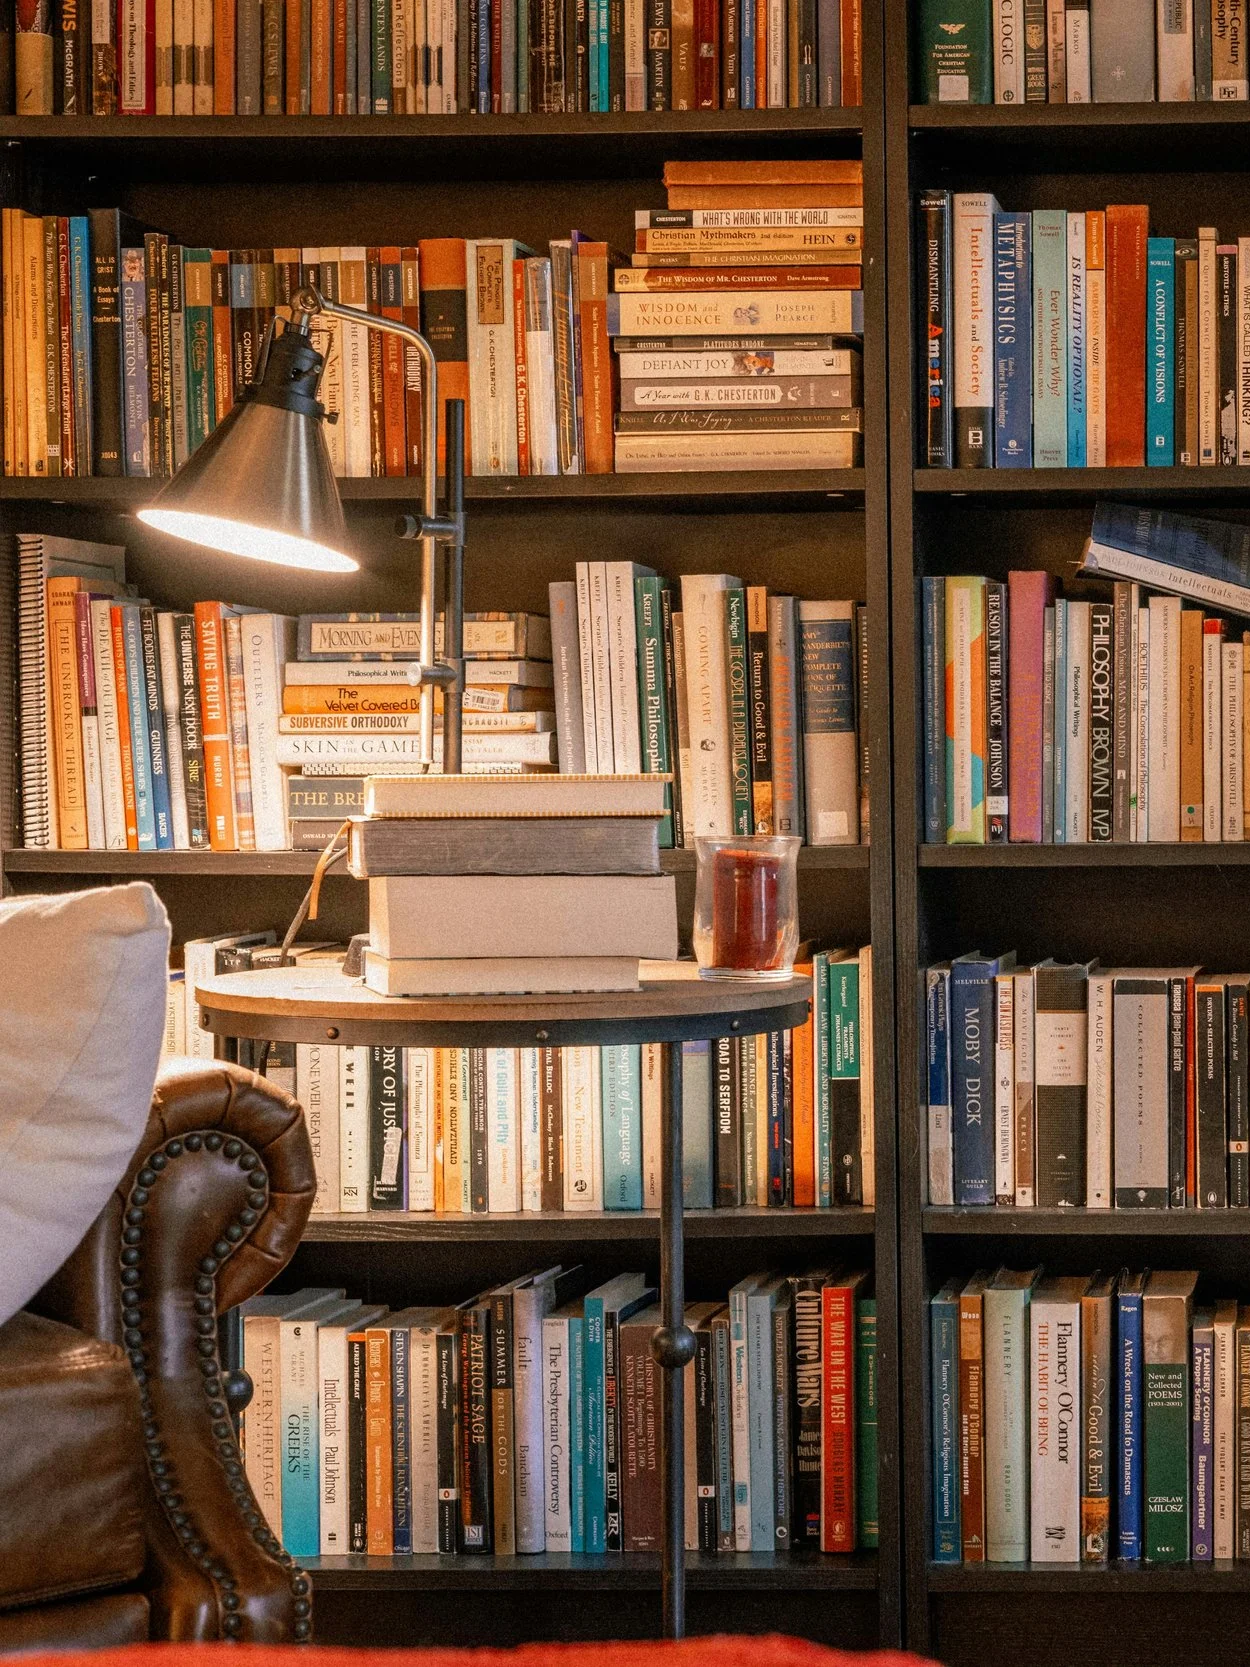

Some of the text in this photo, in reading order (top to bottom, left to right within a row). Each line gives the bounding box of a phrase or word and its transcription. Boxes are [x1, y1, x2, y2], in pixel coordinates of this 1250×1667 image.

[65, 39, 74, 87] McGRATH
[395, 15, 403, 84] Reflections
[1001, 16, 1014, 65] LOGIC
[654, 50, 663, 87] MARTIN
[652, 230, 756, 241] Christian Mythmakers
[702, 210, 829, 226] WHAT'S WRONG WITH THE WORLD
[802, 234, 836, 245] HEIN
[929, 239, 939, 312] DISMANTLING
[970, 227, 984, 321] Intellectuals
[997, 222, 1015, 345] METAPHYSICS
[642, 358, 729, 371] DEFIANT JOY
[1155, 279, 1166, 403] A CONFLICT OF VISIONS
[970, 345, 984, 397] Society
[200, 620, 220, 720] SAVING TRUTH
[645, 637, 657, 692] Summa
[988, 594, 1002, 726] REASON IN THE BALANCE
[325, 700, 408, 712] Velvet Covered
[337, 688, 358, 699] The
[753, 651, 767, 763] Return to Good & Evil
[289, 716, 409, 729] SUBVERSIVE ORTHODOXY
[292, 740, 340, 753] SKIN
[360, 739, 420, 753] GAME
[1092, 614, 1110, 837] PHILOSOPHY BROWN IVP
[213, 755, 222, 788] MURRAY
[989, 739, 1003, 788] JOHNSON
[1172, 1012, 1183, 1047] jean-paul
[719, 1037, 730, 1134] ROAD TO SERFDOM
[964, 1008, 982, 1125] MOBY DICK
[1174, 1048, 1183, 1072] sartre
[620, 1106, 631, 1165] Language
[830, 1296, 846, 1425] THE WAR ON THE WEST
[1148, 1381, 1182, 1389] Collected
[470, 1334, 486, 1444] PATRIOT SAGE
[1038, 1321, 1049, 1456] THE HABIT OF BEING
[1055, 1322, 1073, 1463] Flannery O'Connor
[288, 1414, 300, 1473] GREEKS
[324, 1378, 339, 1504] Intellectuals Paul Johnson
[607, 1472, 617, 1501] KELLY
[1149, 1504, 1183, 1512] MILOSZ
[1197, 1455, 1206, 1530] Baumgaertner
